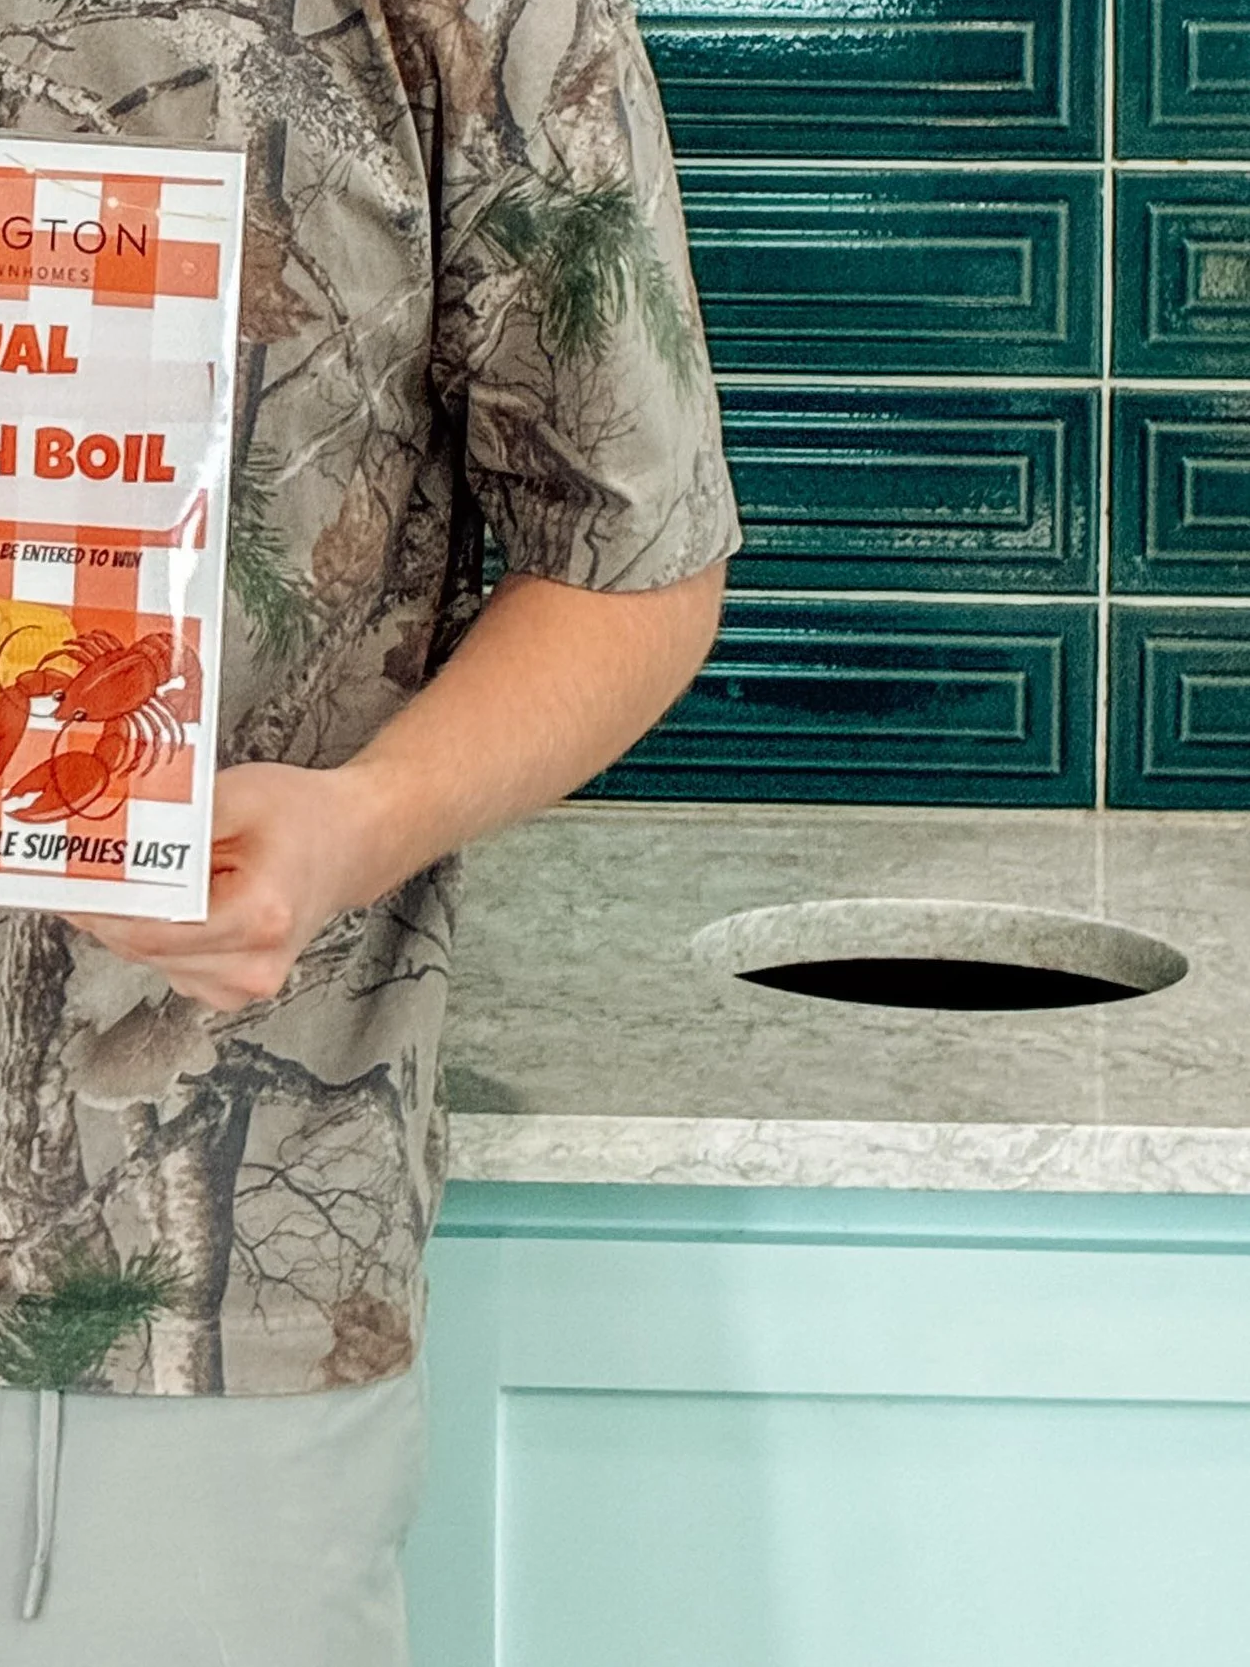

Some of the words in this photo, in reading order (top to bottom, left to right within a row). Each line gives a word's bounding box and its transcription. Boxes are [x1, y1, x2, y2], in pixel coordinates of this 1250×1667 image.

[33, 426, 175, 483] BOIL
[0, 543, 20, 561] BE
[21, 544, 86, 565] ENTERED
[88, 548, 109, 567] TO
[111, 550, 143, 569] WIN
[22, 833, 128, 865] SUPPLIES
[132, 840, 191, 870] LAST
